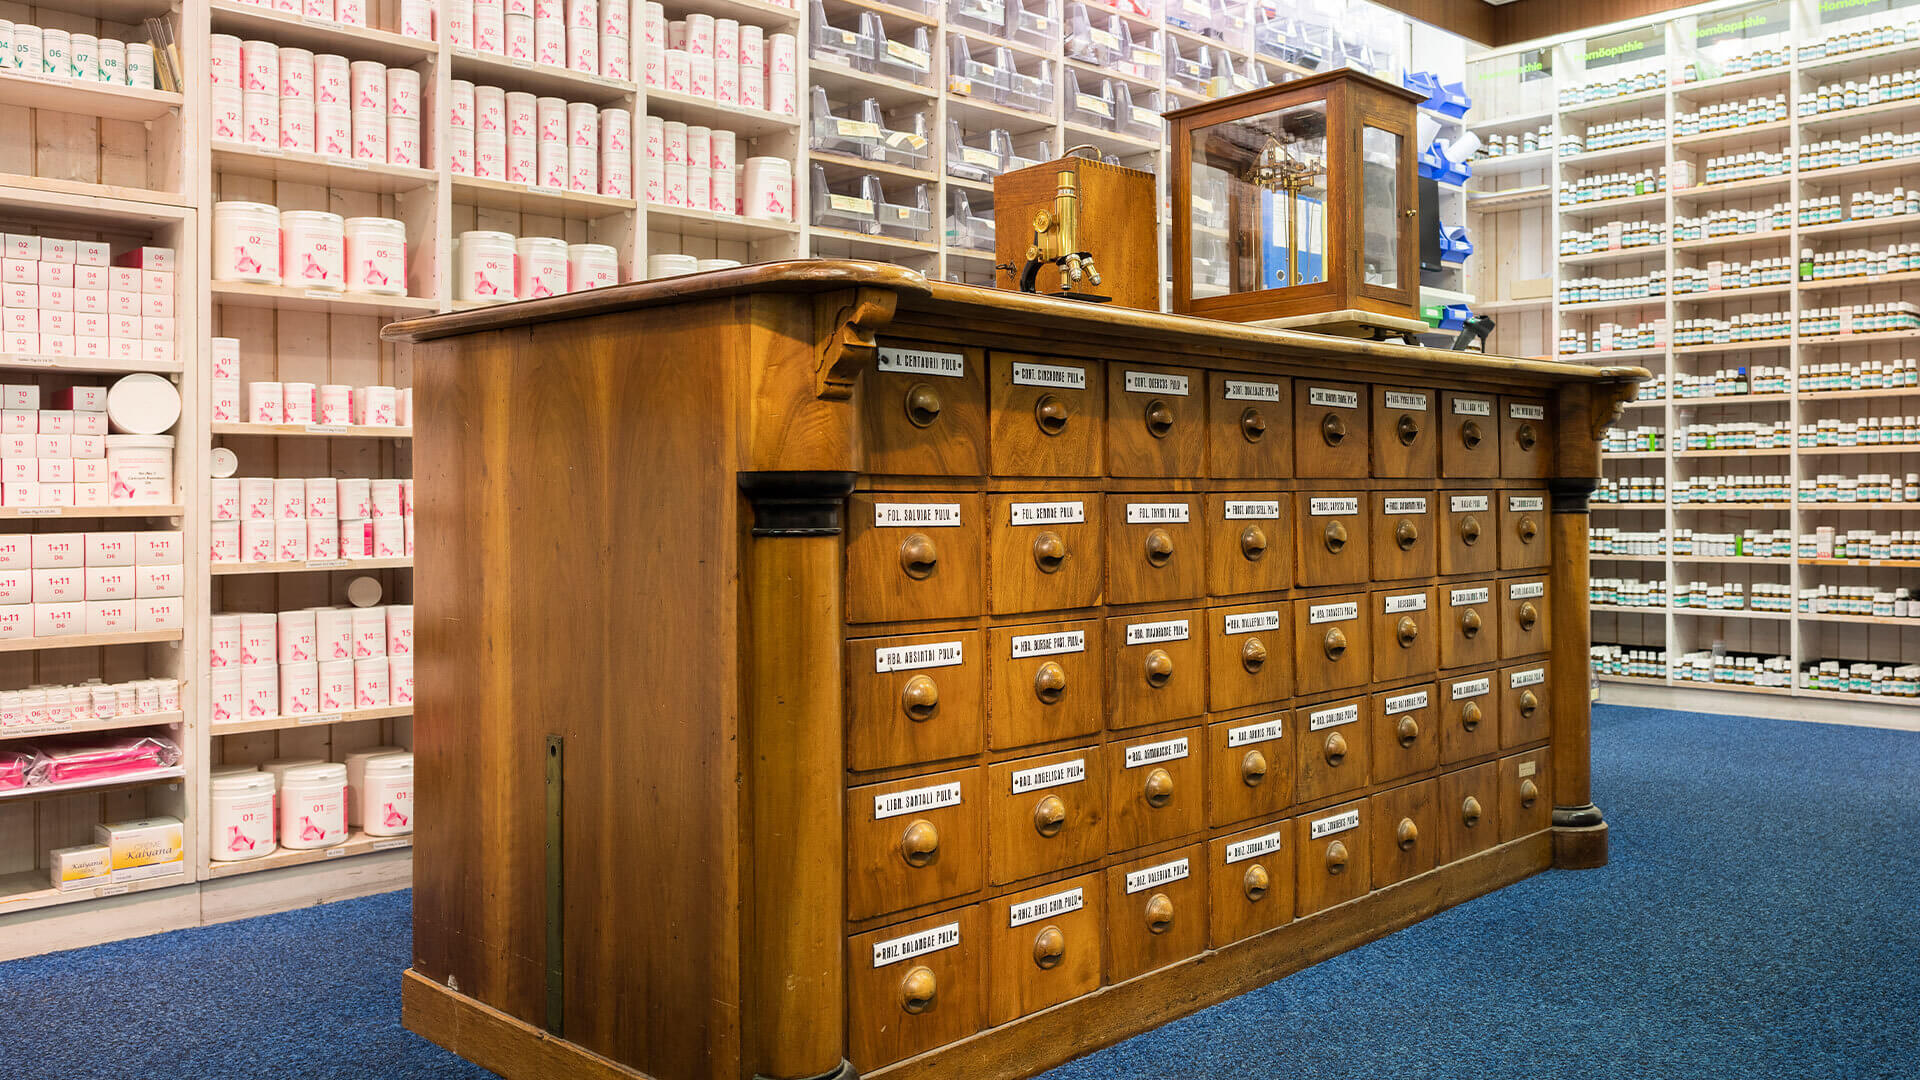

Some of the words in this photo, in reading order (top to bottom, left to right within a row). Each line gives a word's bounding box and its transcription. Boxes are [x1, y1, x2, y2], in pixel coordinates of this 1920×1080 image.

[451, 21, 461, 29] 01
[484, 28, 494, 36] 02
[17, 45, 29, 53] 05
[77, 54, 88, 62] 07
[211, 58, 221, 66] 12
[105, 59, 117, 67] 08
[257, 65, 268, 73] 13
[292, 72, 302, 80] 14
[329, 78, 339, 86] 15
[370, 84, 379, 92] 16
[227, 112, 236, 120] 12
[259, 118, 269, 126] 13
[291, 123, 301, 131] 14
[649, 136, 658, 144] 24
[250, 236, 261, 244] 02
[316, 243, 327, 251] 04
[377, 250, 388, 258] 05
[543, 267, 553, 275] 07
[887, 508, 901, 521] FOL.
[904, 509, 931, 521] SALVIAE
[1139, 508, 1149, 518] FOL.
[50, 612, 71, 620] 1+11
[887, 652, 901, 665] HBA.
[938, 647, 954, 660] PULV.
[1034, 768, 1063, 784] ANGELICAE
[396, 792, 407, 800] 01
[886, 796, 903, 811] LIGN.
[905, 791, 932, 808] SANTALI
[936, 788, 952, 803] PULV.
[313, 804, 324, 813] 01
[242, 814, 253, 822] 01
[127, 847, 172, 861] Kalyana
[71, 859, 103, 870] Kalyana
[1018, 905, 1032, 920] RHIZ.
[882, 943, 899, 960] RHIZ.
[902, 934, 935, 955] GALANGAE
